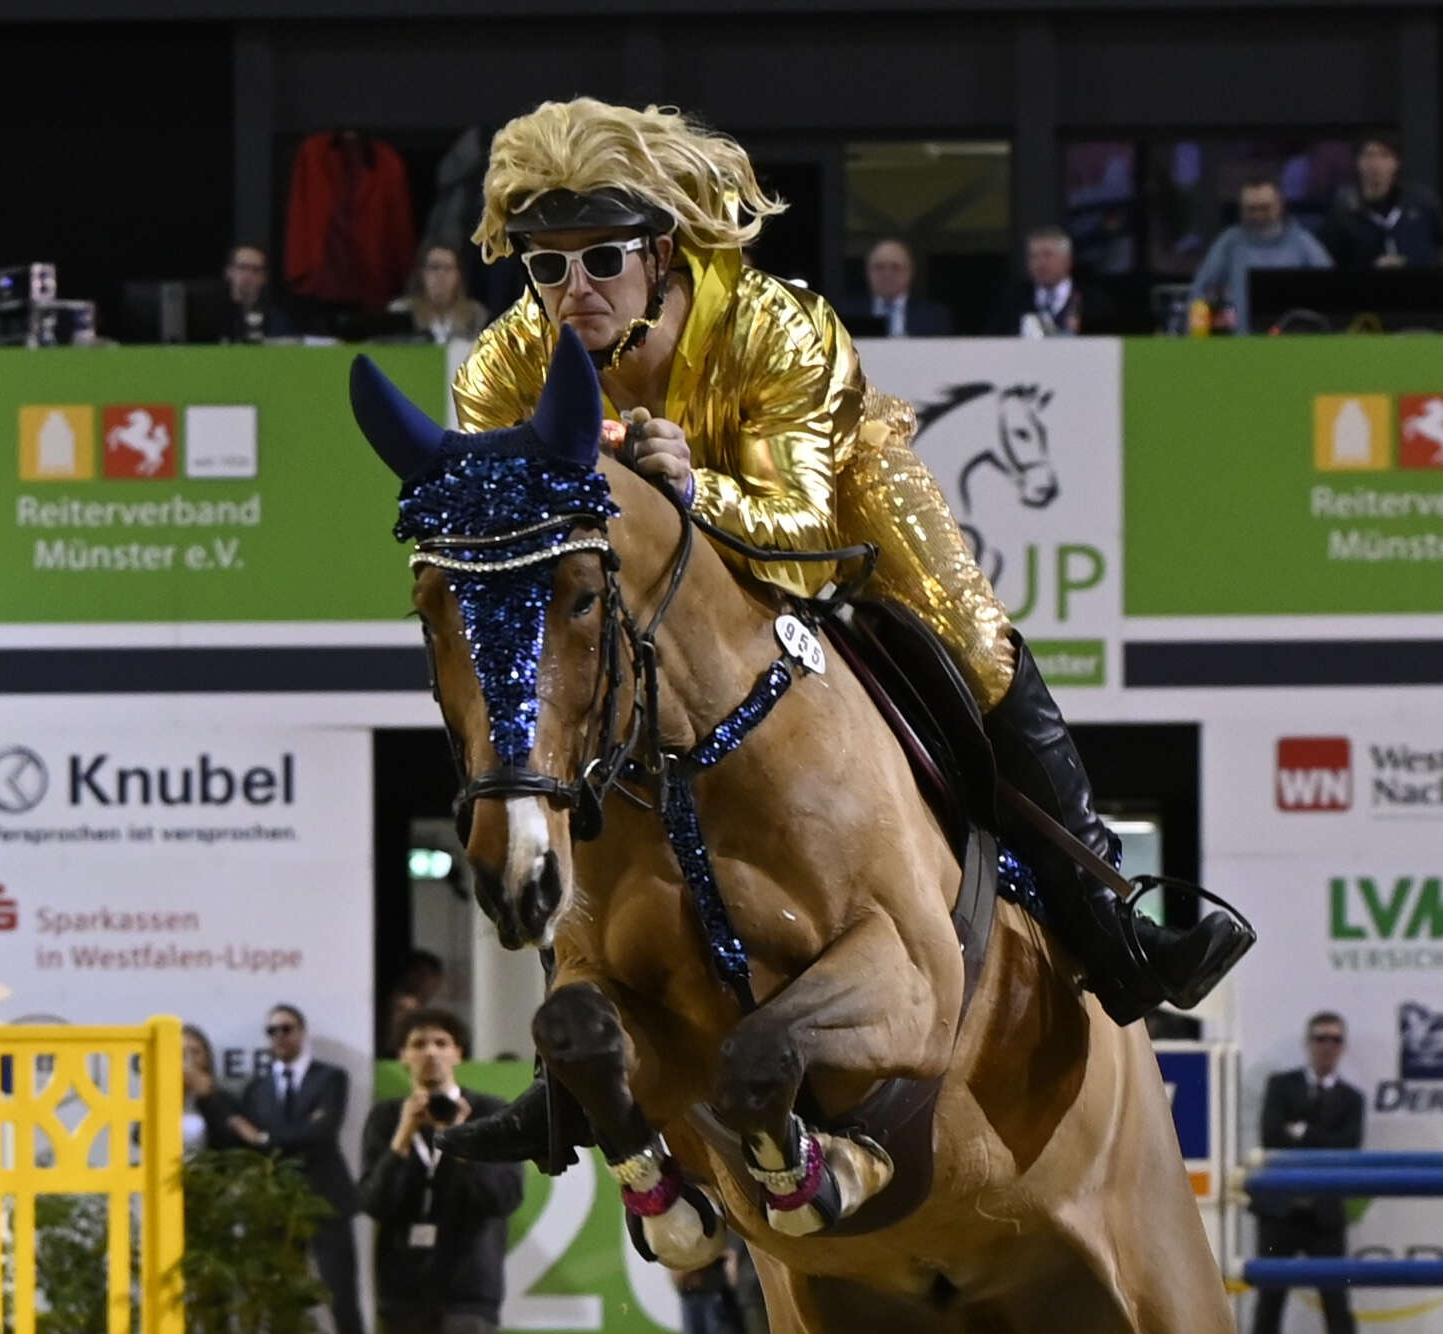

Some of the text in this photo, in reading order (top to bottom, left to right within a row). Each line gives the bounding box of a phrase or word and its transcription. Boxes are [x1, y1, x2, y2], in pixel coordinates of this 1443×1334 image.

[16, 495, 262, 526] Reiterverband
[33, 539, 244, 569] Münster e.V.
[784, 622, 821, 665] 955
[68, 752, 296, 806] Knubel
[1278, 767, 1349, 806] WN
[128, 823, 154, 843] ist
[35, 907, 200, 936] Sparkassen
[35, 945, 303, 975] in Westfalen-Lippe
